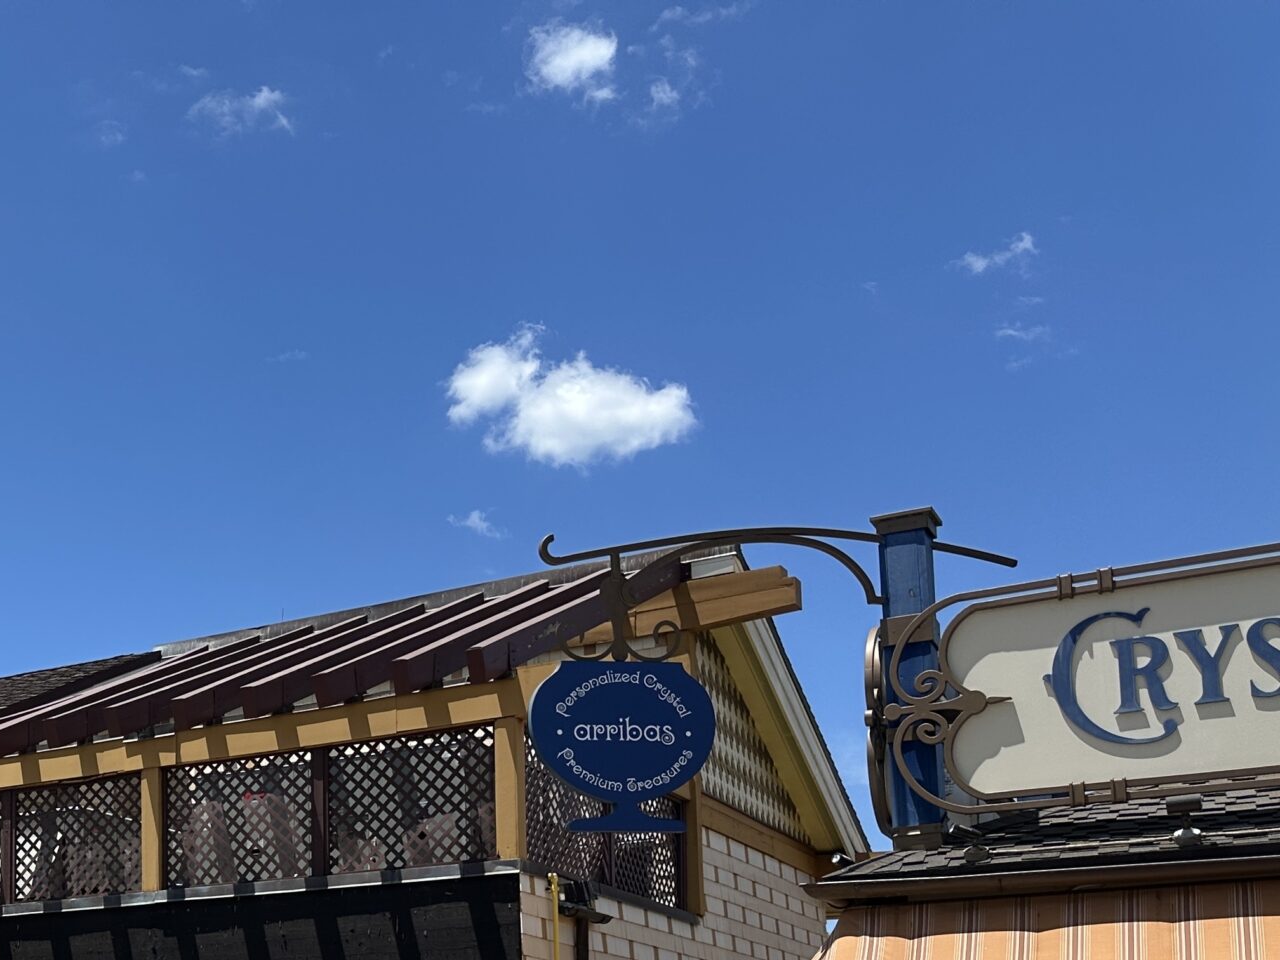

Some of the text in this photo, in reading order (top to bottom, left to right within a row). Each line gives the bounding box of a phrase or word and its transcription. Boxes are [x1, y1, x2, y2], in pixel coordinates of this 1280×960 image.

[556, 670, 692, 718] Personalized Crystal
[573, 717, 675, 745] arribas
[557, 748, 693, 792] Premium Treasures
